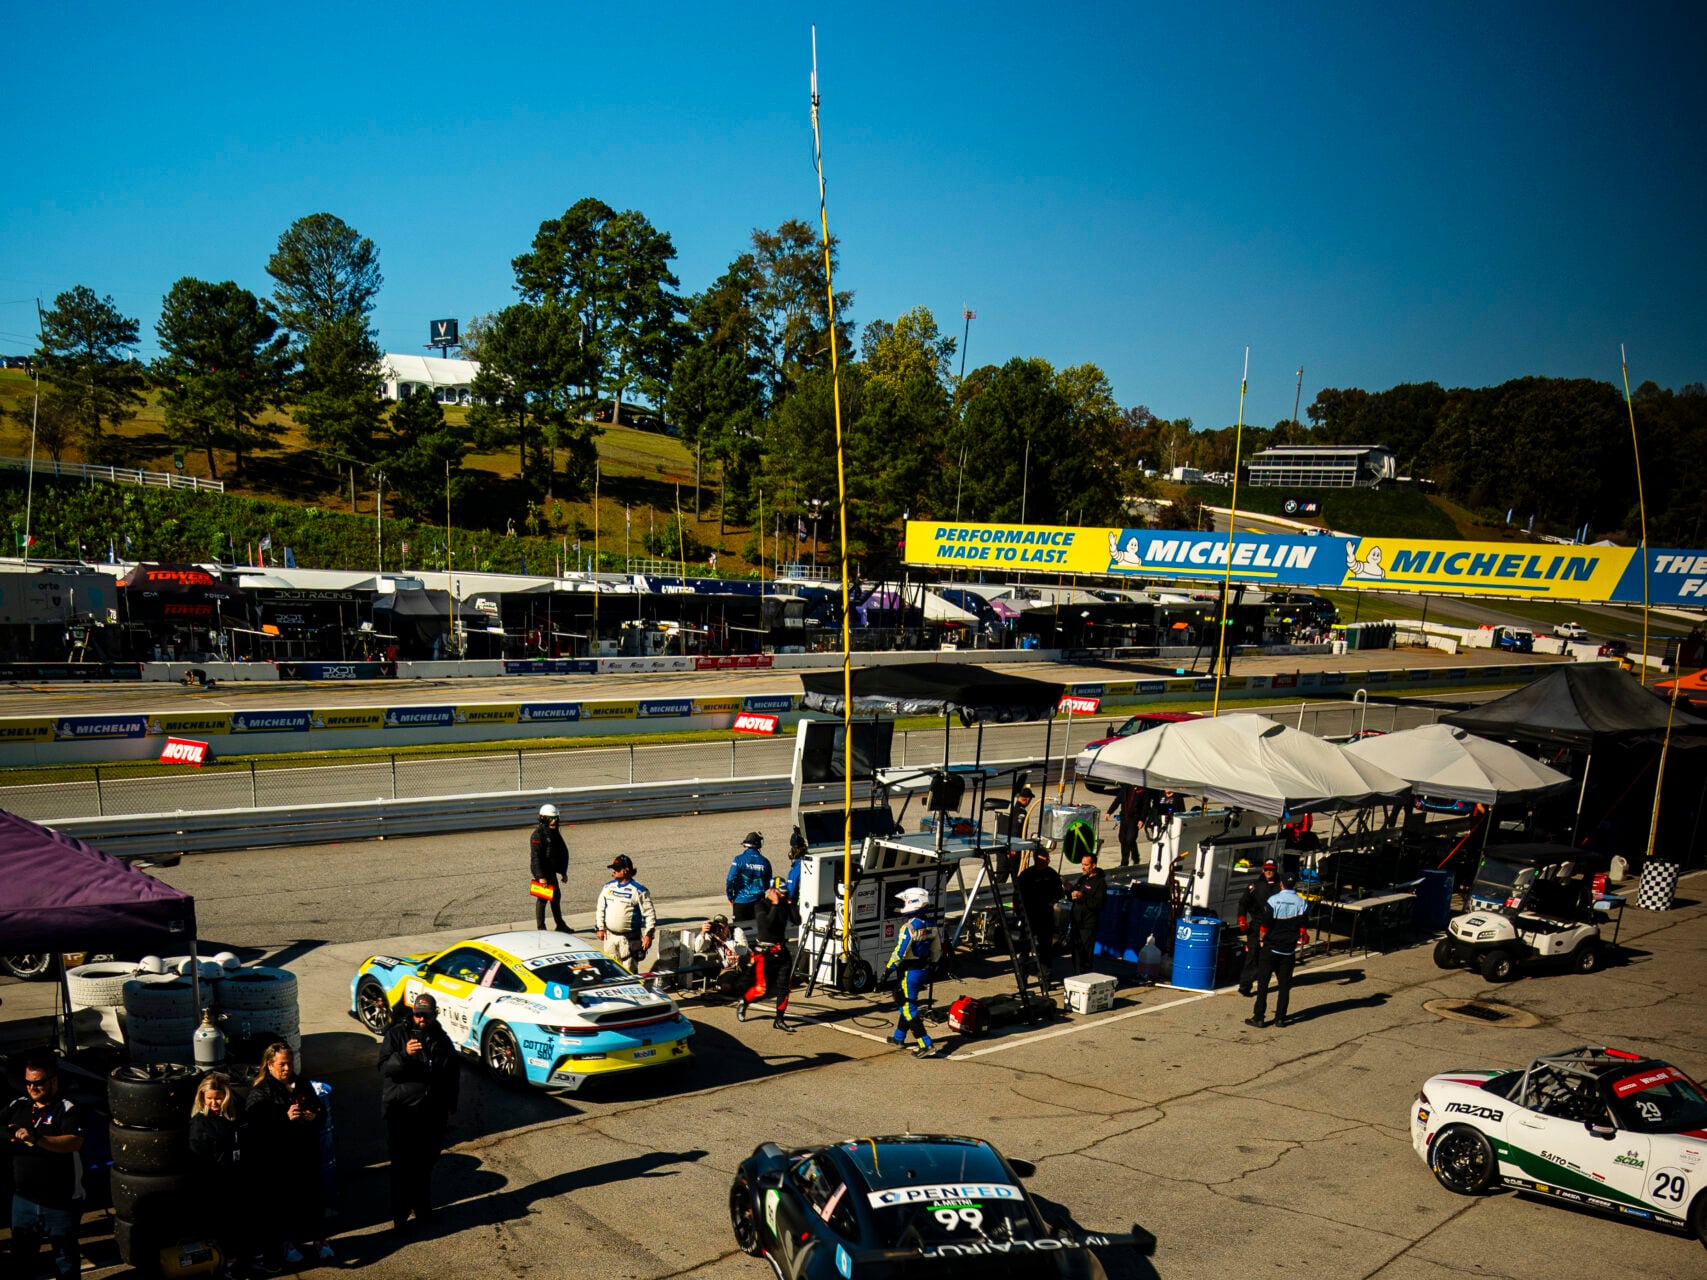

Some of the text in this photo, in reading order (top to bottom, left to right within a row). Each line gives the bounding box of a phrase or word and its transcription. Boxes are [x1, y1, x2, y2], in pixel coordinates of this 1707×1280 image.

[934, 527, 1076, 547] PERFORMANCE
[936, 544, 1068, 564] MADE TO LAST.
[1145, 540, 1318, 569] MICHELIN
[1389, 550, 1600, 582] MICHELIN
[1653, 554, 1707, 574] THE
[146, 570, 212, 582] TOWER
[309, 591, 353, 600] RACING
[164, 603, 213, 615] TOWER
[592, 706, 634, 716] MICHELIN
[649, 704, 689, 714] MICHELIN
[703, 702, 740, 711] MICHELIN
[752, 700, 790, 710] MICHELIN
[400, 713, 450, 722] MICHELIN
[468, 711, 515, 721] MICHELIN
[531, 708, 577, 719] MICHELIN
[166, 720, 226, 730] MICHELIN
[249, 717, 305, 728] MICHELIN
[327, 715, 379, 725] MICHELIN
[735, 716, 775, 732] MOTUL
[76, 723, 141, 734] MICHELIN
[162, 742, 204, 763] MOTUL
[1176, 925, 1192, 941] 59
[545, 952, 605, 965] PENFED
[595, 987, 646, 998] PENFED
[511, 997, 548, 1012] PENFED
[523, 1039, 555, 1051] COTTON
[537, 1049, 553, 1061] SOX
[1444, 1102, 1505, 1123] mazda
[1637, 1101, 1662, 1118] 29
[1539, 1150, 1567, 1166] SAITO
[1614, 1155, 1646, 1168] SCDA
[906, 1185, 1013, 1201] PENFED
[1652, 1172, 1685, 1203] 29
[933, 1199, 973, 1208] A.METNI
[934, 1207, 984, 1232] 99
[1085, 1235, 1111, 1246] fly
